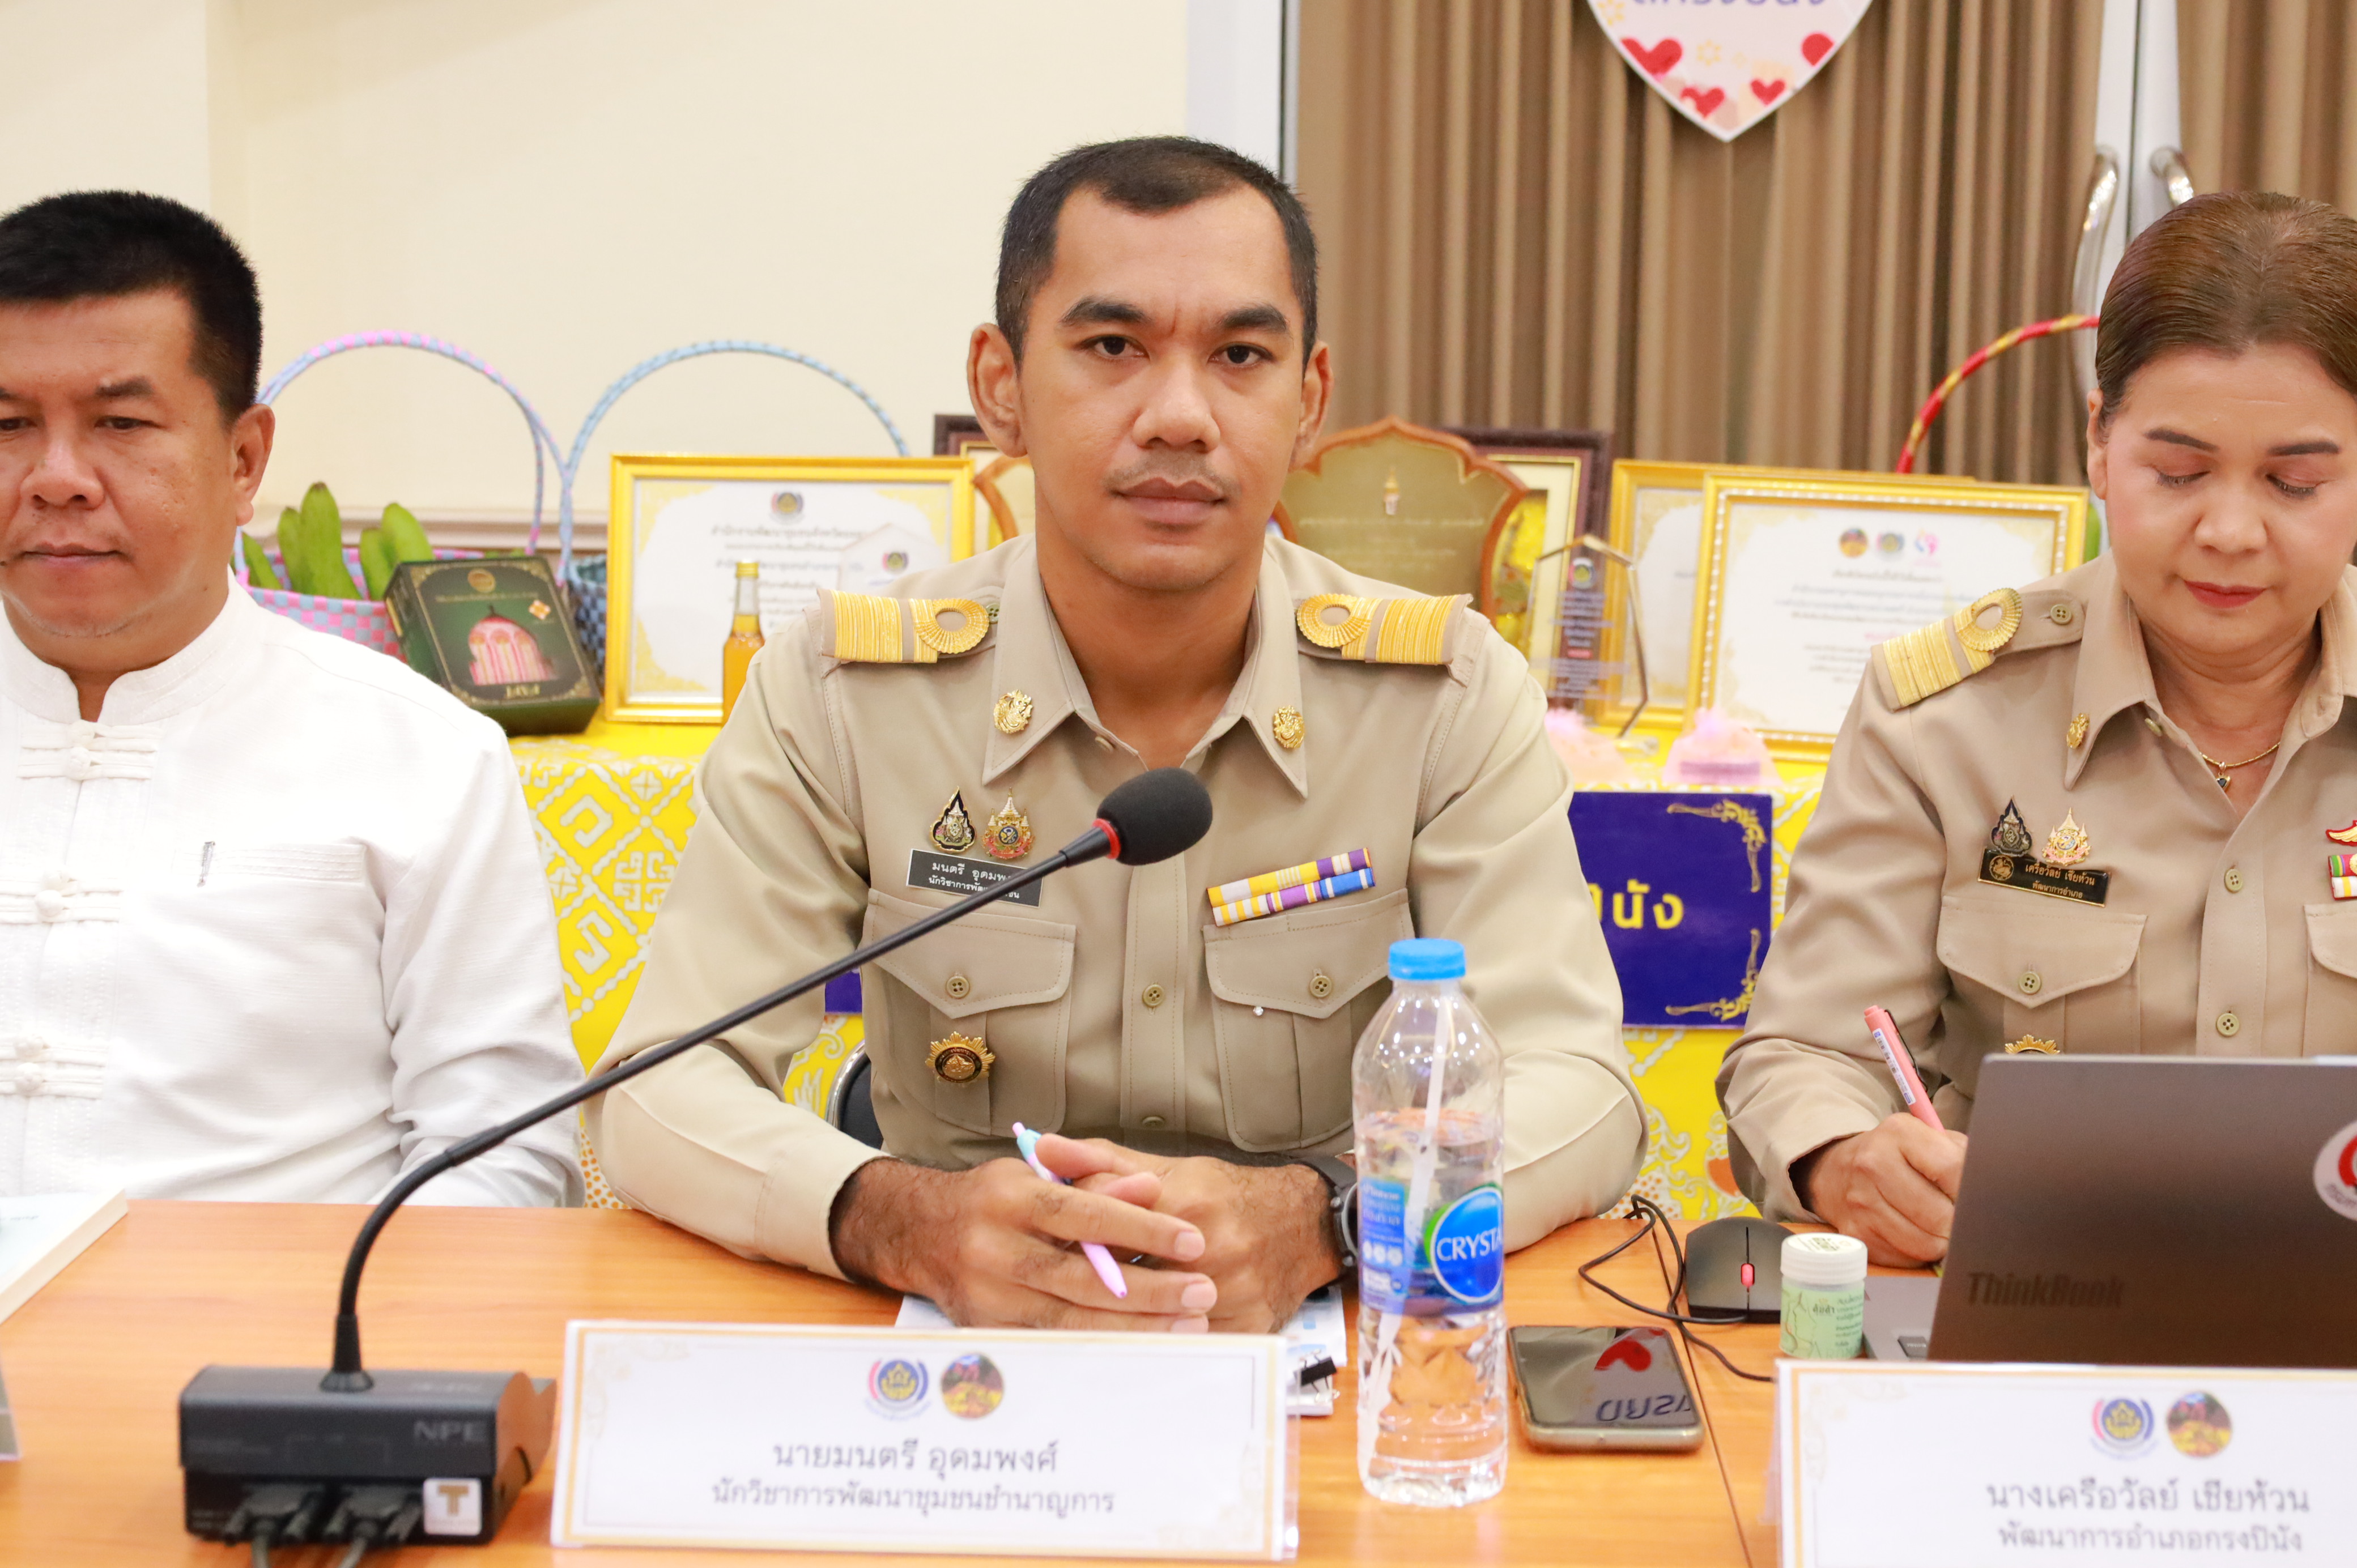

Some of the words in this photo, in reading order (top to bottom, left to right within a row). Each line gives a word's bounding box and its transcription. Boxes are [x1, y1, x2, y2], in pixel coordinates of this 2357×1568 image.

[931, 862, 965, 875] มนตรี
[972, 870, 1012, 883] อุดมพ
[2032, 880, 2083, 899] พัฒนาการอำเภอ
[1967, 1271, 2125, 1308] ThinkBook
[414, 1420, 489, 1445] NPE
[773, 1438, 919, 1471] นายมนตรี
[928, 1440, 1060, 1481] อุดมพงศ์
[712, 1476, 1117, 1520] นักวิชาการพัฒนาชุมชนชำนาญการ
[1986, 1476, 2179, 1511] นางเครือวัลย์
[1998, 1520, 2304, 1551] พัฒนาการอำเภอกรงปินัง
